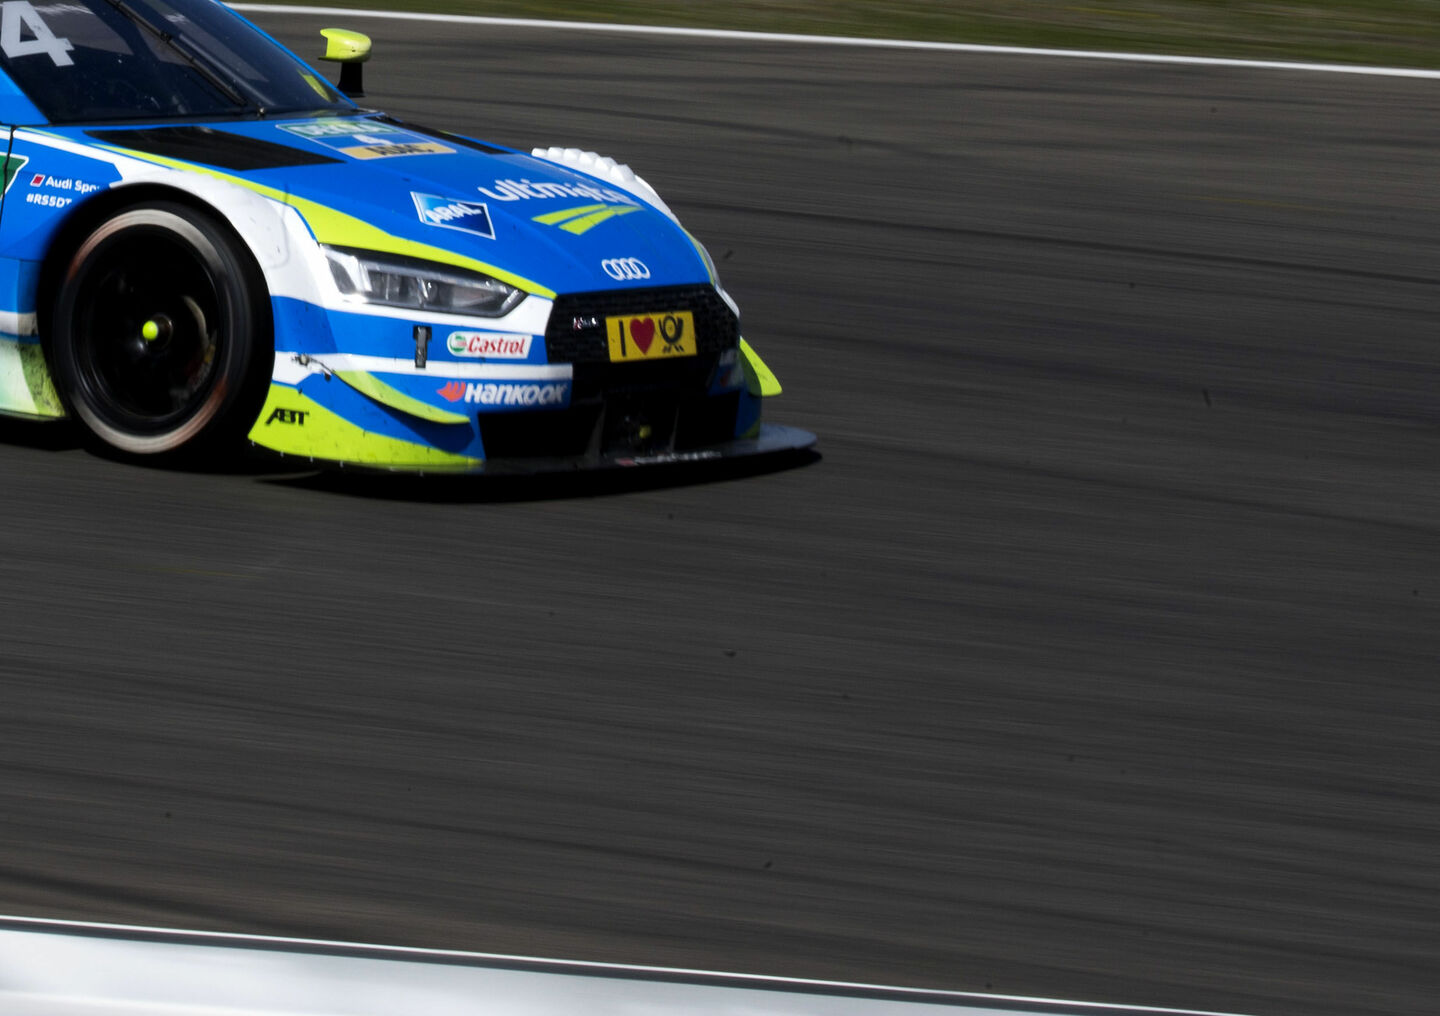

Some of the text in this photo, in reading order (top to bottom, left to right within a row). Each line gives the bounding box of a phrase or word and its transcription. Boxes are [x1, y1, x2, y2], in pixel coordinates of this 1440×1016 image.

[0, 0, 75, 67] 4
[45, 176, 72, 190] Audi
[425, 202, 483, 224] ARAL
[466, 335, 526, 355] Castrol
[464, 382, 569, 407] Hankook
[265, 407, 309, 426] ABT
